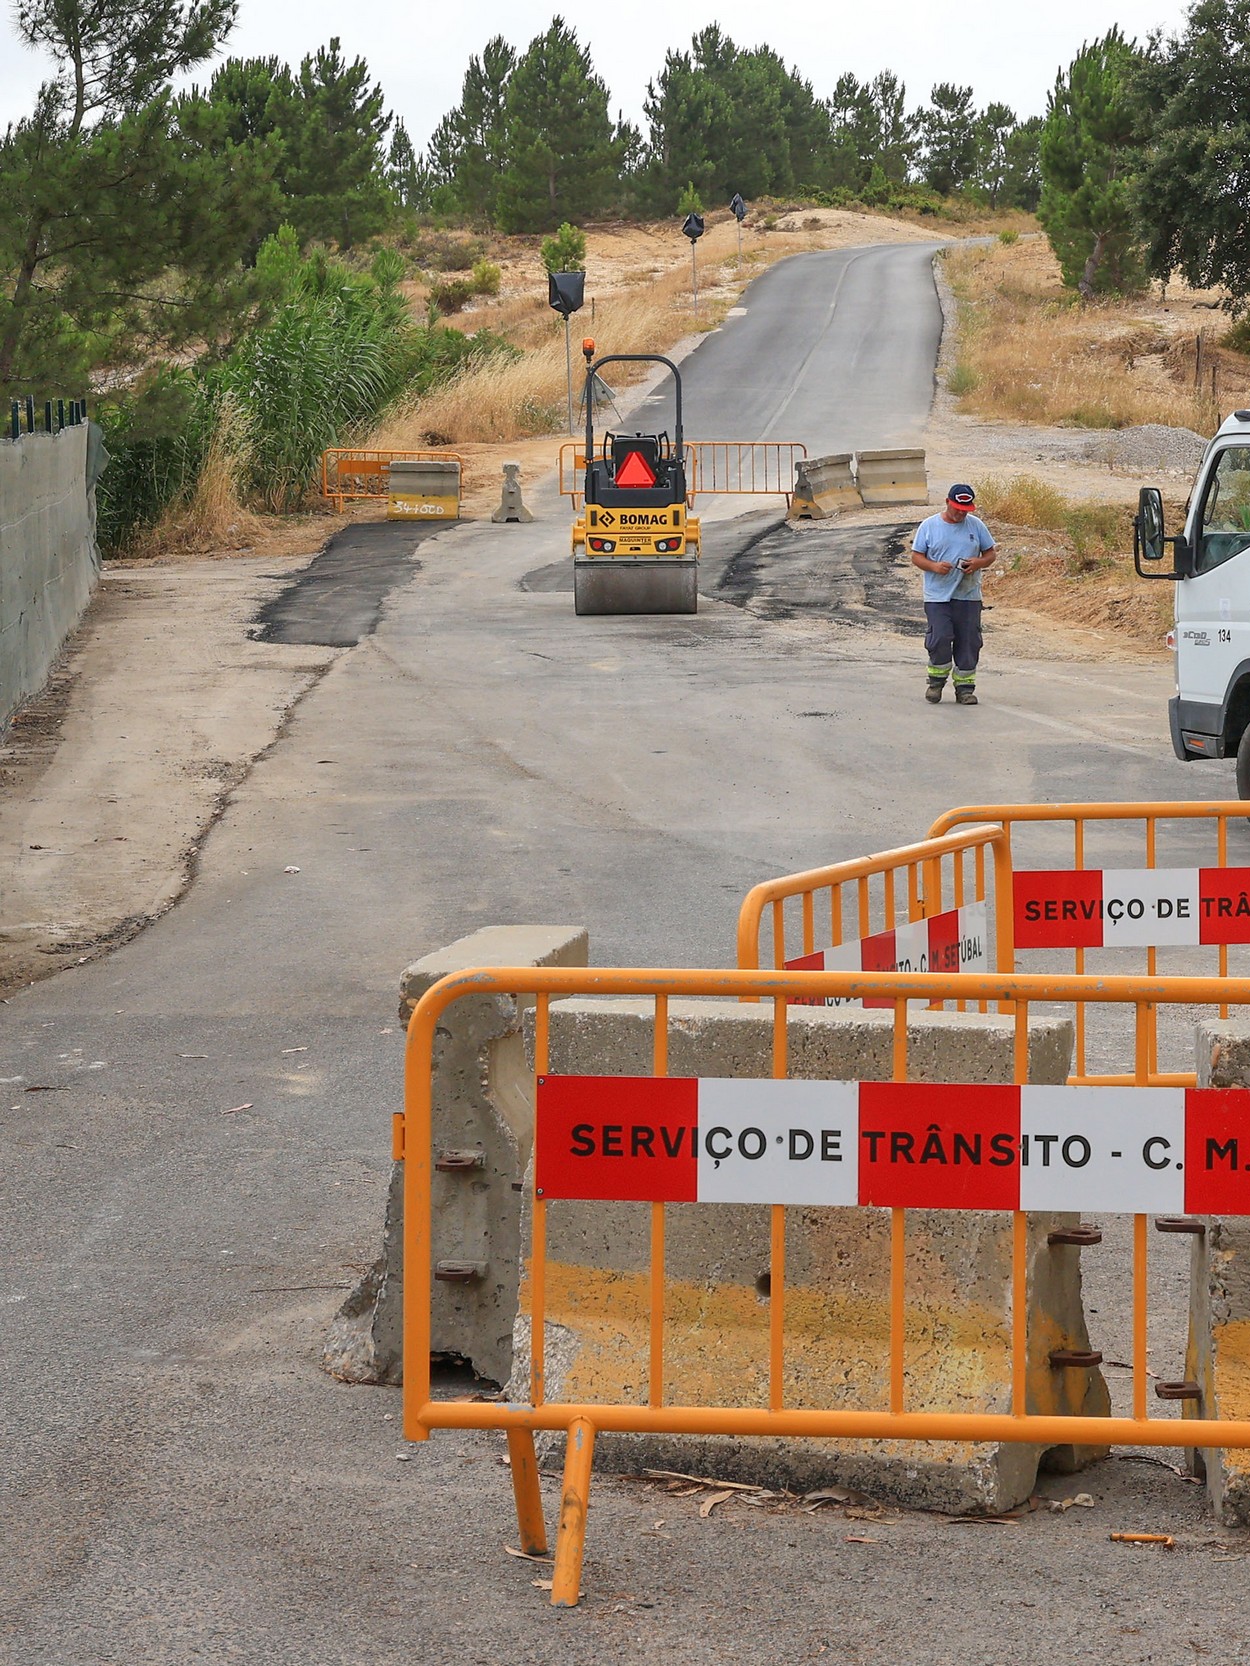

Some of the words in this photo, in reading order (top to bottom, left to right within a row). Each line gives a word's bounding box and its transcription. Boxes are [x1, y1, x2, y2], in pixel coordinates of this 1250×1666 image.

[619, 514, 668, 525] BOMAG
[1218, 629, 1231, 643] 134
[1025, 899, 1145, 925] SERVIÇO
[1156, 898, 1190, 918] DE
[944, 935, 982, 968] SETÚBAL
[570, 1123, 767, 1169] SERVIÇO
[788, 1129, 843, 1162] DE
[862, 1125, 1092, 1168] TRÂNSITO
[1142, 1136, 1183, 1170] C.
